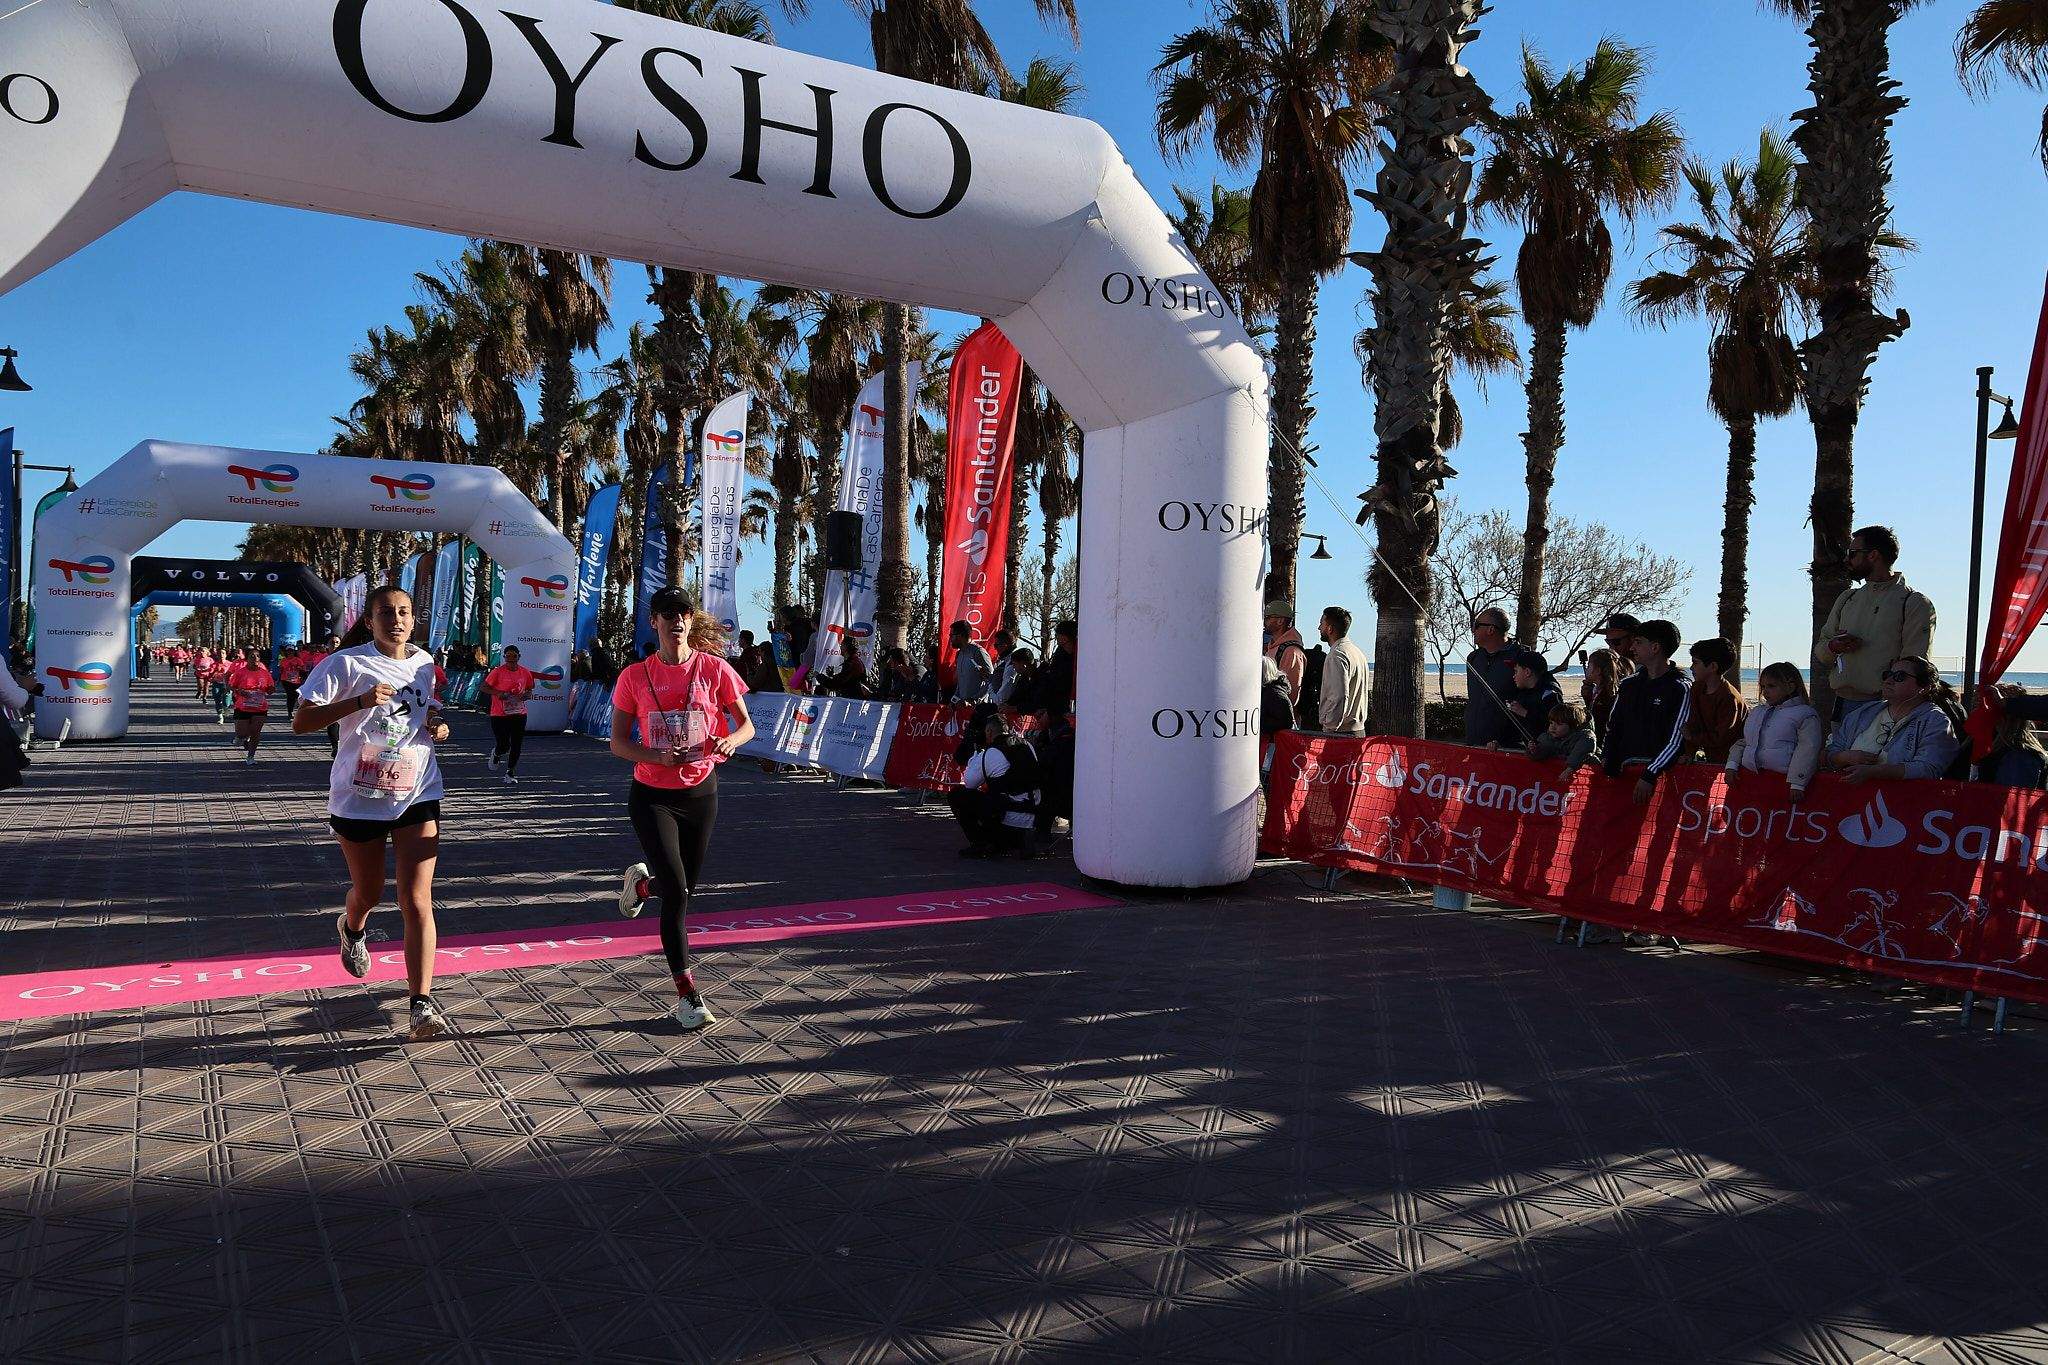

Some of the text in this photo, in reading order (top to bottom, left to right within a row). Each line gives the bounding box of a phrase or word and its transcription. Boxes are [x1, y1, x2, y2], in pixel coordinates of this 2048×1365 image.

[333, 0, 971, 219] OYSHO
[1101, 272, 1225, 319] OYSHO
[228, 495, 300, 508] TotalEnergies
[370, 504, 436, 515] TotalEnergies
[964, 365, 1000, 643] ports Santander
[164, 569, 279, 582] VOLVO
[579, 532, 603, 605] Marlene
[48, 588, 115, 598] TotalEnergies
[519, 601, 568, 612] TotalEnergies
[47, 629, 114, 637] totalenergies.es
[46, 696, 112, 705] TotalEnergies
[906, 716, 944, 741] Sports
[1291, 754, 1577, 816] Sports Santander
[1678, 789, 1830, 845] Sports
[896, 890, 1059, 914] OYSHO
[18, 962, 313, 1000] OYSHO
